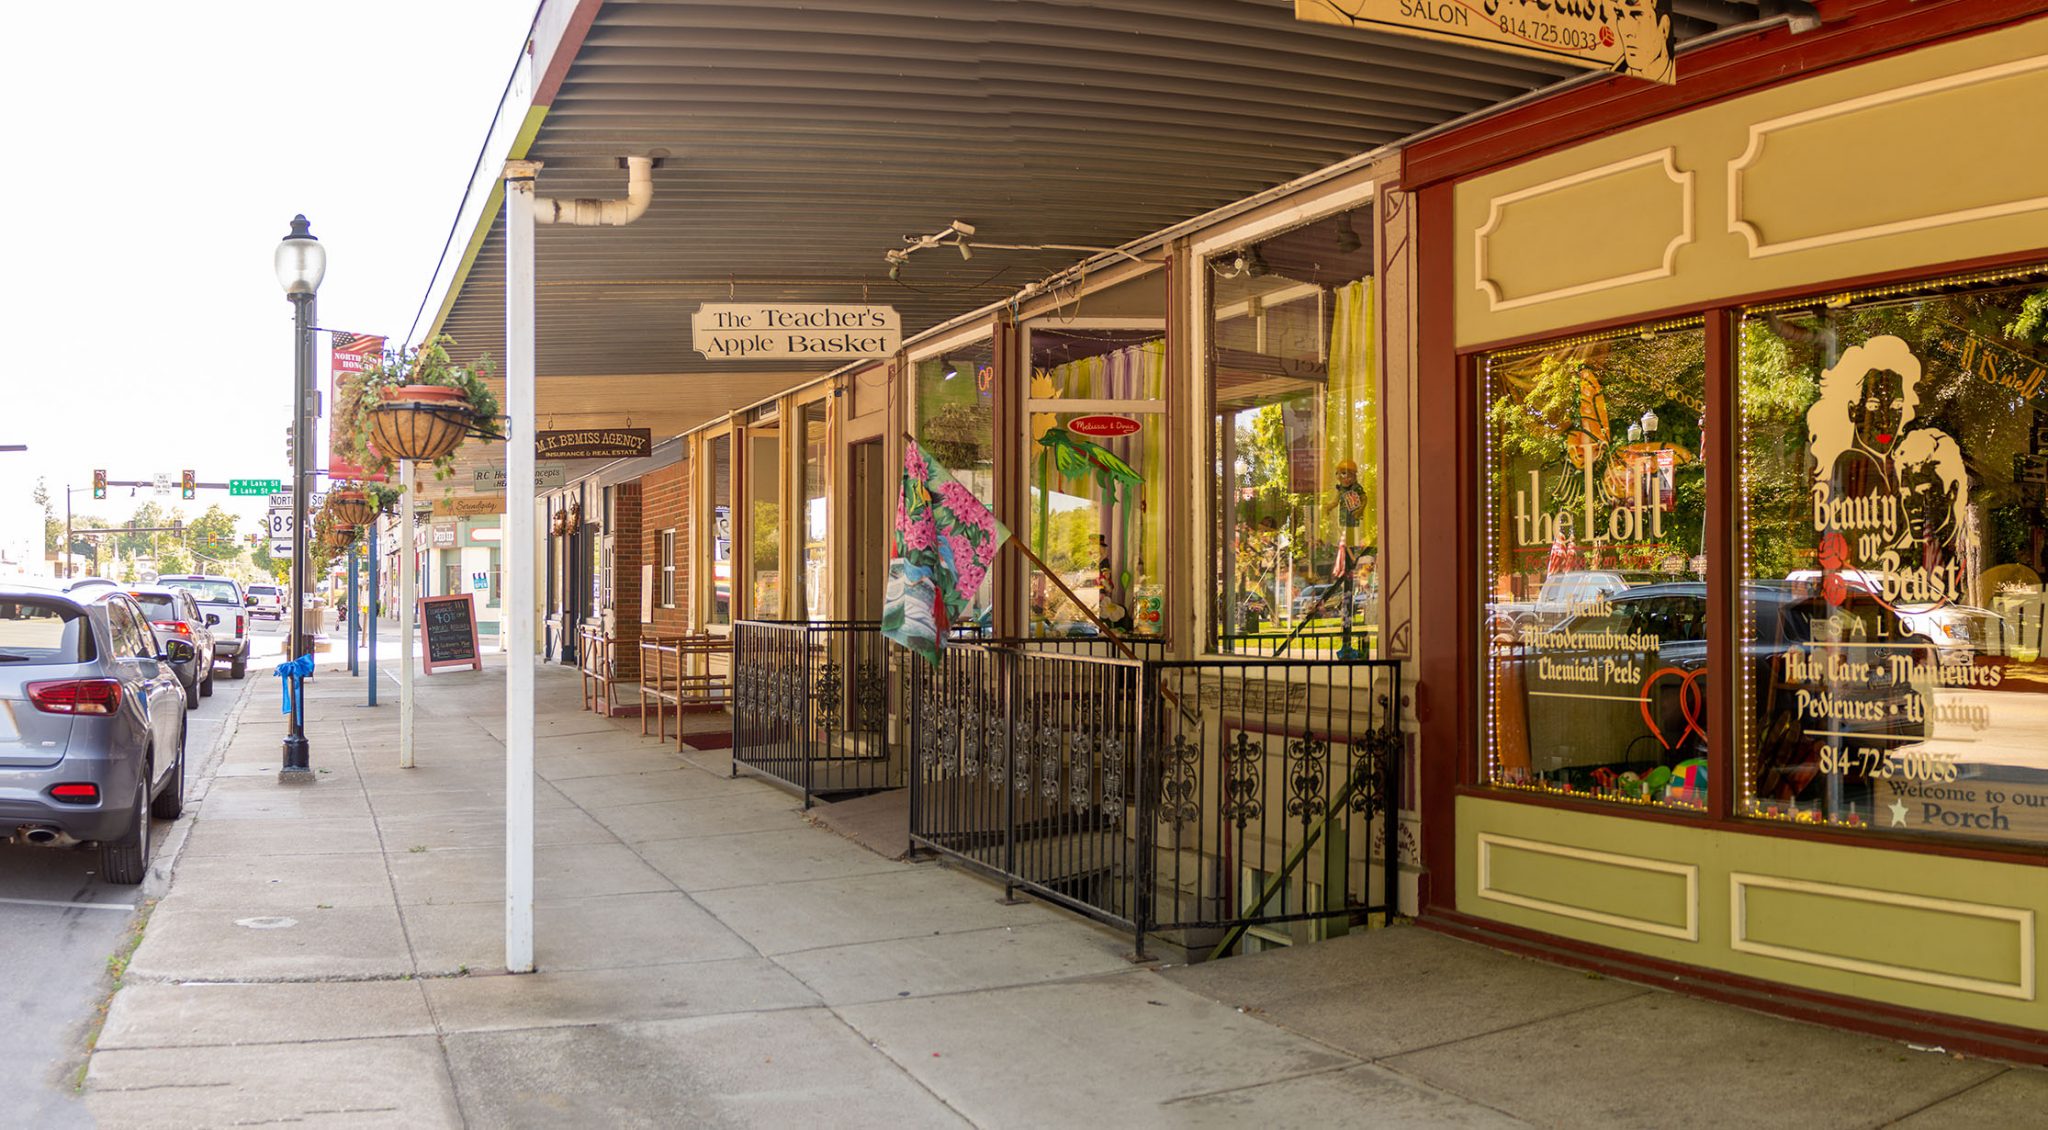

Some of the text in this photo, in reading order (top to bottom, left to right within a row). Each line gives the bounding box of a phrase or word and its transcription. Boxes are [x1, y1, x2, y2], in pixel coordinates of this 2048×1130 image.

[1400, 0, 1468, 26] SALON
[1500, 15, 1597, 50] 814.725.0033
[714, 308, 885, 327] The Teacher's
[708, 335, 887, 356] Apple Basket
[560, 432, 600, 446] BEMISS
[601, 432, 646, 449] AGENCY
[1116, 422, 1134, 433] Doug
[1514, 440, 1667, 546] the Loft
[273, 516, 293, 532] 89
[1811, 480, 1897, 543] Beauty
[1858, 533, 1883, 563] or
[1877, 550, 1961, 602] Beast
[1525, 625, 1660, 651] Microdermabrasion
[1828, 615, 1945, 637] SALON
[1538, 655, 1641, 686] Chemical Peels
[1783, 652, 2001, 687] Hair Care Manicures
[1796, 689, 1884, 720] Pedicures
[1889, 780, 2048, 807] Welcome to our
[1922, 802, 2010, 831] Porch
